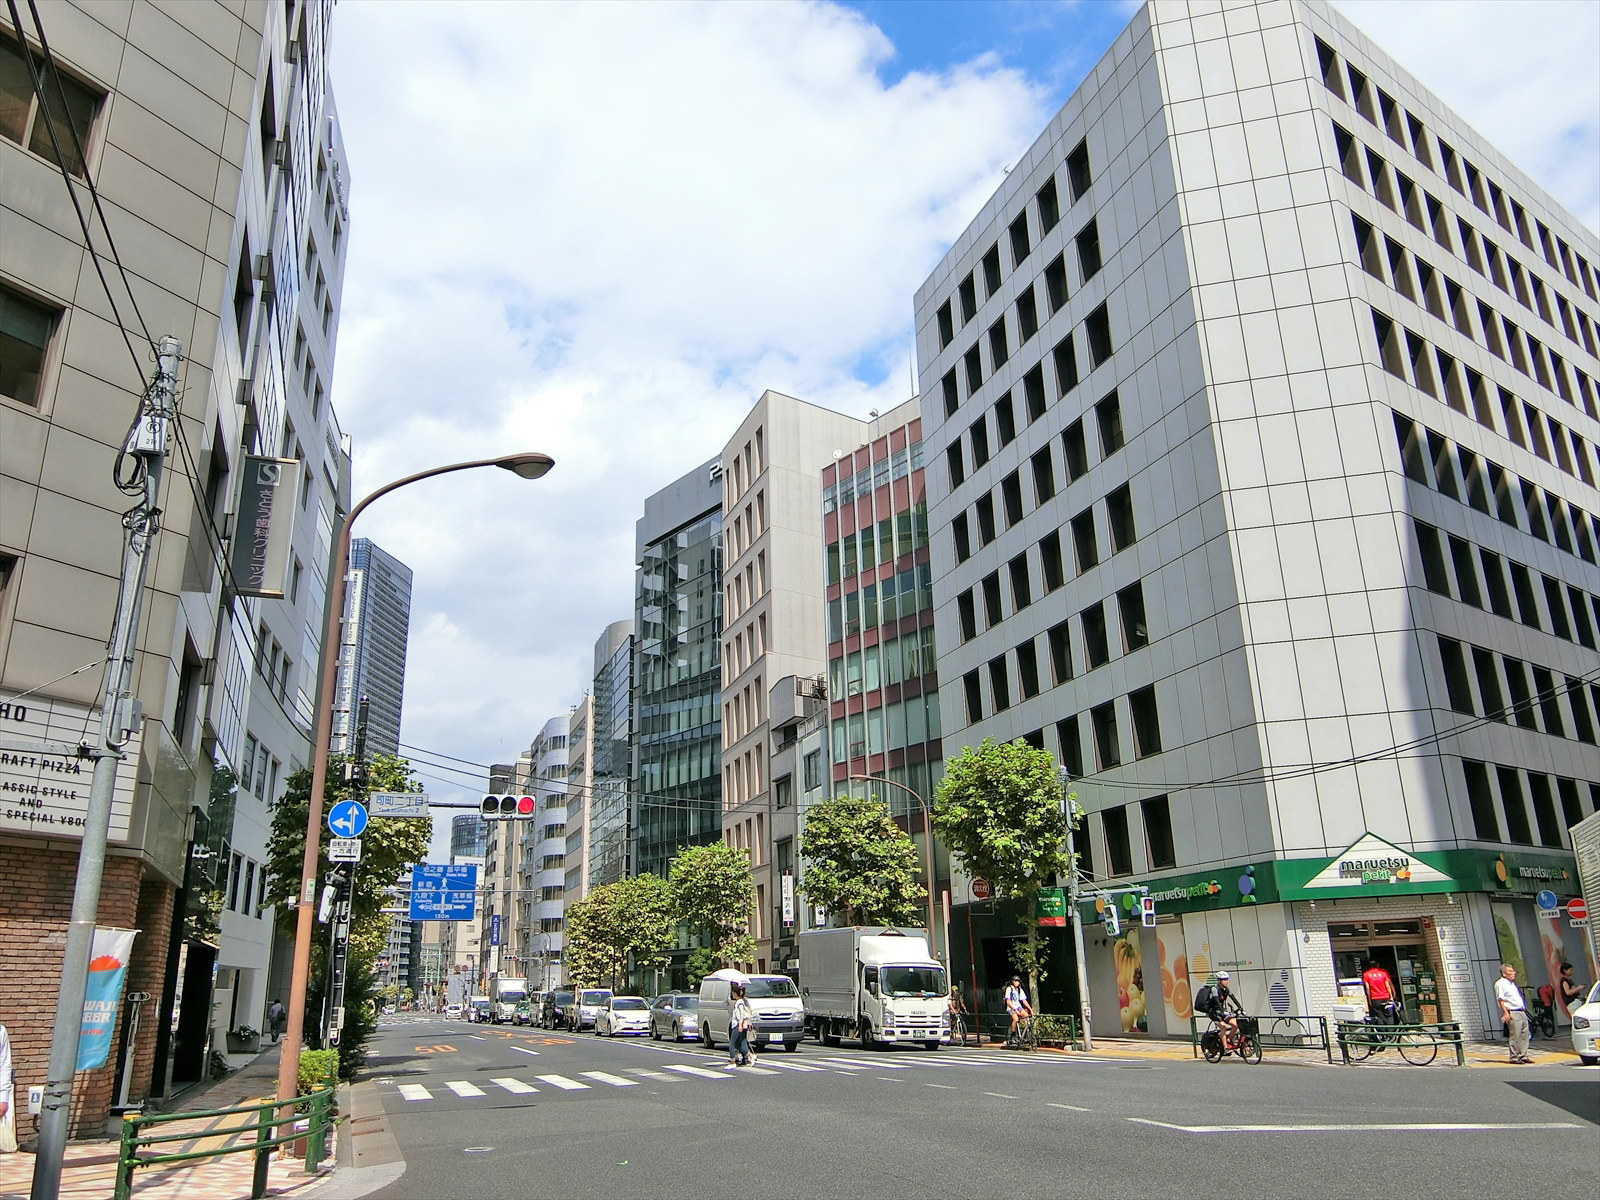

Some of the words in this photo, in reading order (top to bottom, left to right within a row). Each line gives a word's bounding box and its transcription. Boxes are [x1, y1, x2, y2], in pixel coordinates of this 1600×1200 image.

[248, 489, 273, 585] さとう歯科クリニック
[1, 753, 37, 768] RAFT
[42, 759, 80, 775] PIZZA
[1, 781, 38, 795] ASSIC
[42, 787, 77, 800] STYLE
[19, 797, 43, 809] AND
[376, 795, 424, 806] 司町二丁目
[6, 809, 55, 824] SPECIAL
[1341, 857, 1409, 870] maruetsu
[1363, 868, 1391, 883] petit
[82, 1012, 111, 1023] EER
[414, 1044, 458, 1054] 50
